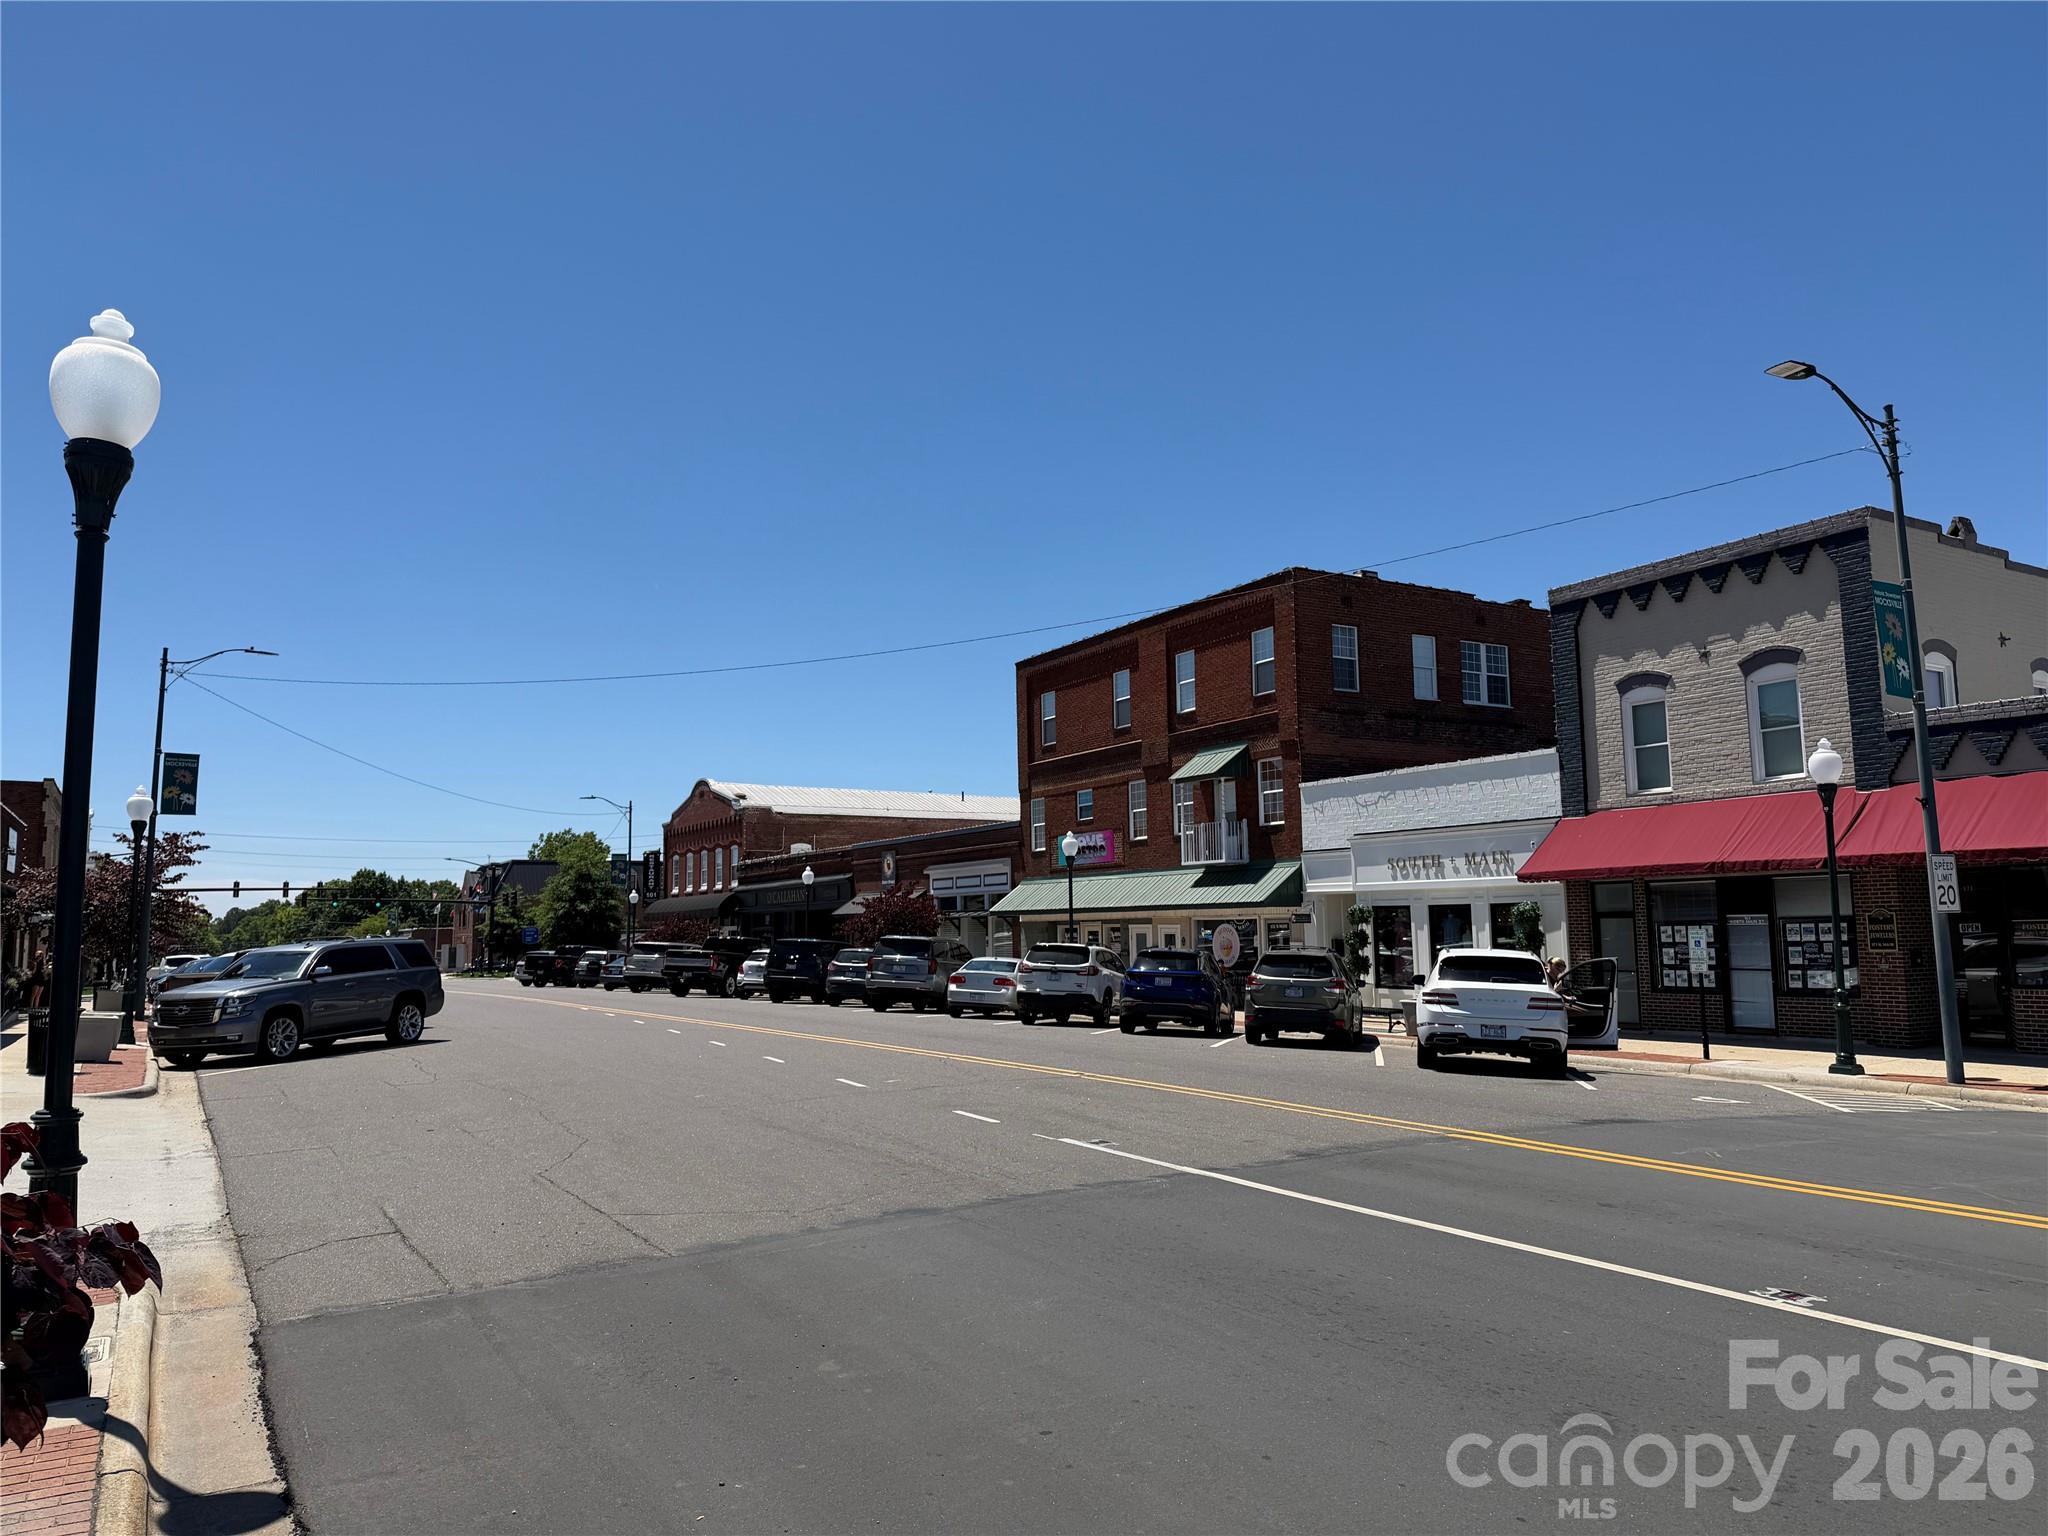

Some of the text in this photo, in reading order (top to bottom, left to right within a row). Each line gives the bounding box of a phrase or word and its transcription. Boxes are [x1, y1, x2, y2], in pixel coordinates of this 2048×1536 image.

[1387, 854, 1442, 871] SOUTH
[1464, 850, 1513, 866] MAIN
[1933, 859, 1955, 872] SPEED
[1937, 872, 1953, 882] LIMIT
[1937, 884, 1957, 905] 20
[1960, 924, 1980, 932] OPEN
